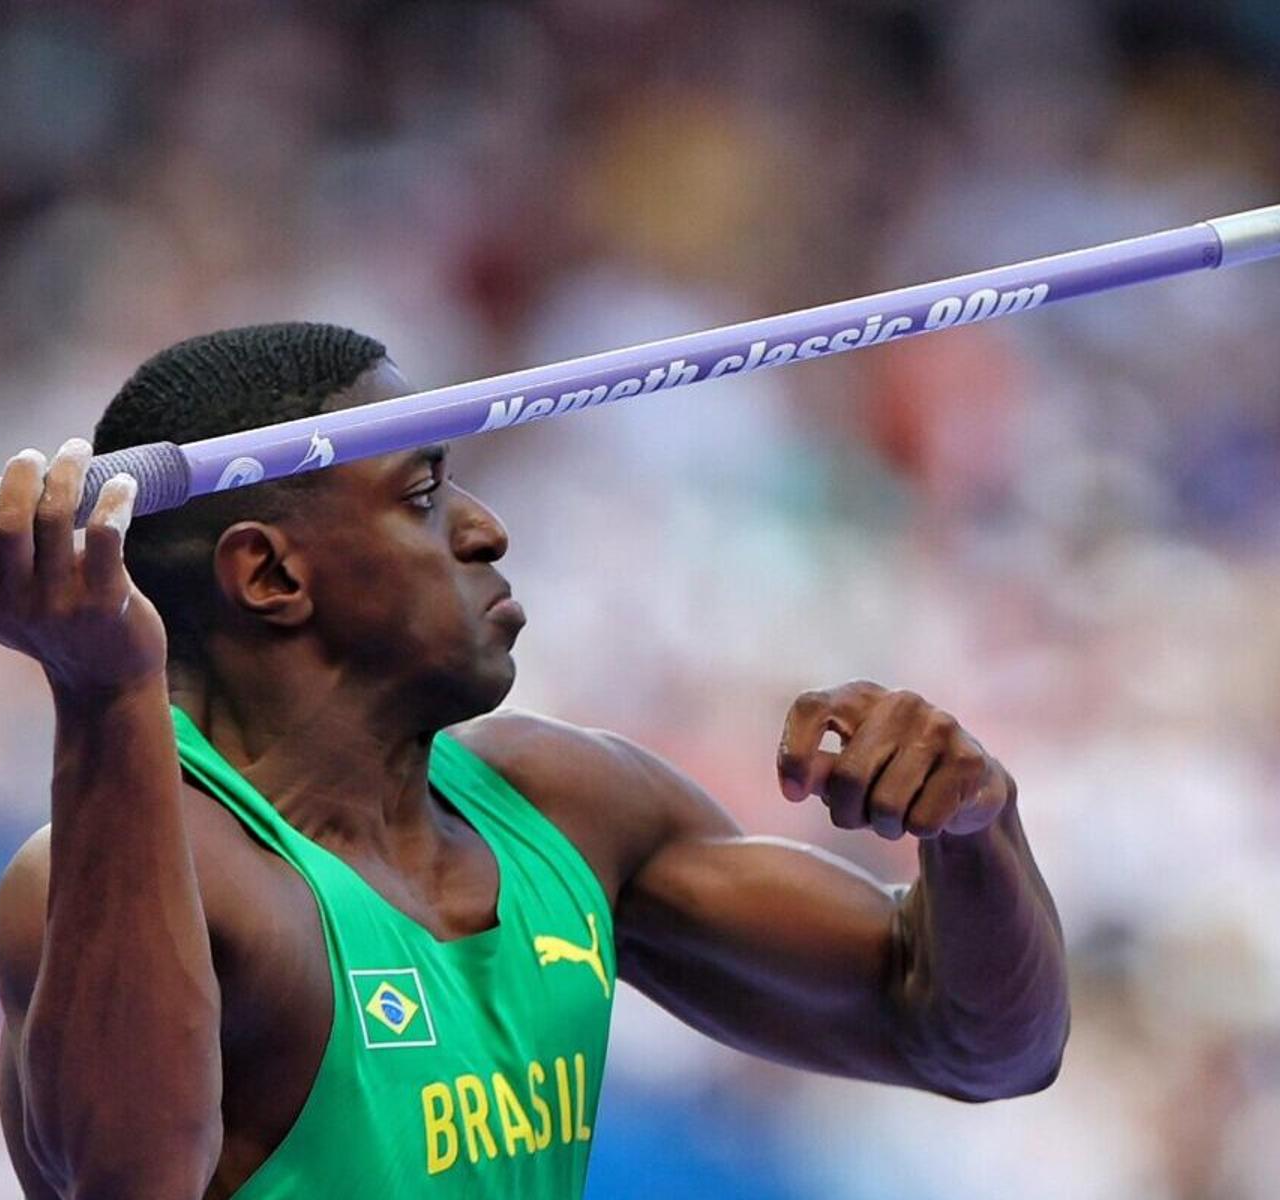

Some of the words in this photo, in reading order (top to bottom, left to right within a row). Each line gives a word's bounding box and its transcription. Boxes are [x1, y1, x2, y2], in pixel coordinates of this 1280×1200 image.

[477, 360, 699, 433] Nemeth
[705, 314, 913, 379] classic
[422, 1053, 591, 1174] BRASIL
